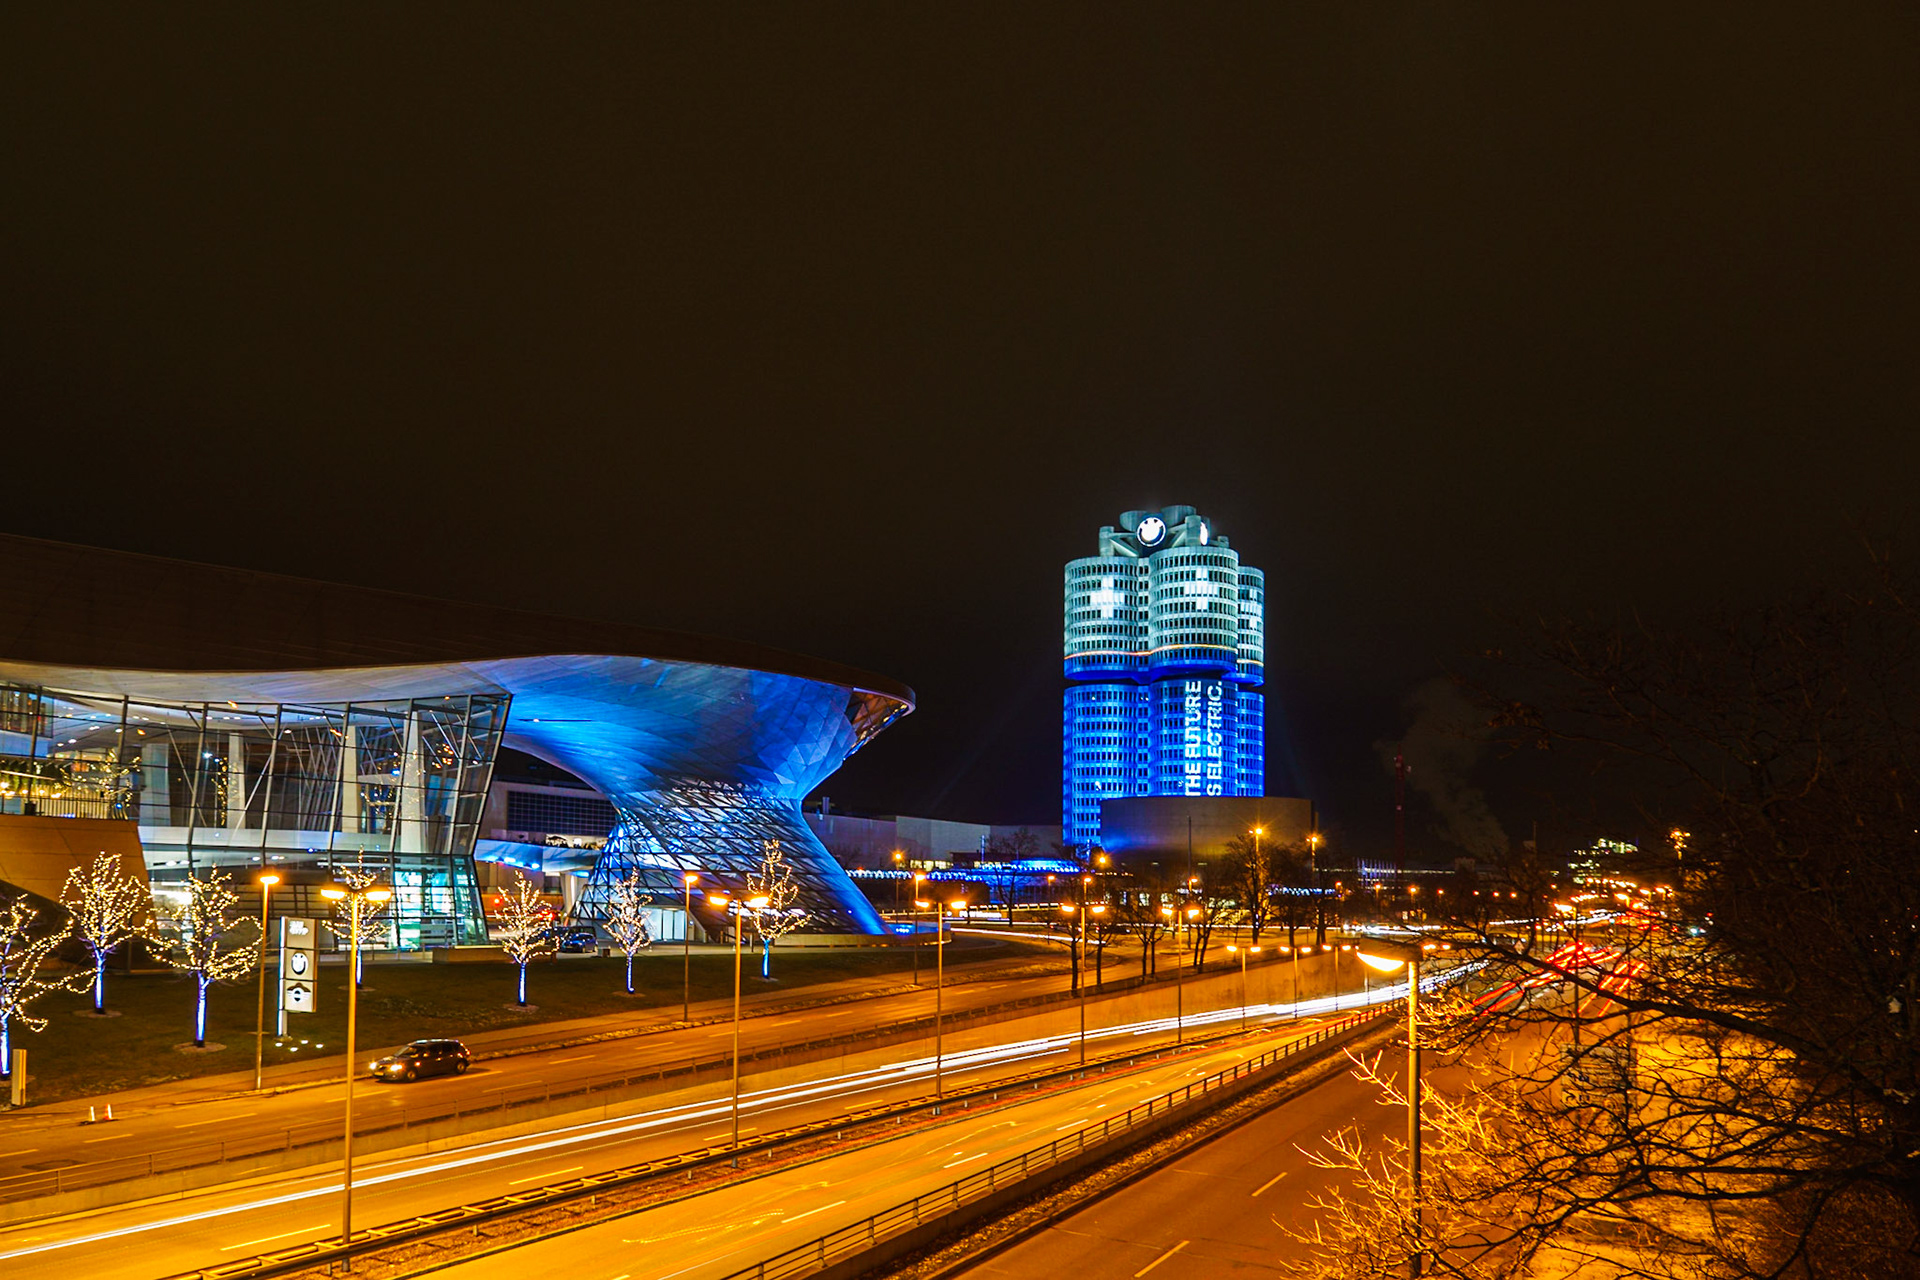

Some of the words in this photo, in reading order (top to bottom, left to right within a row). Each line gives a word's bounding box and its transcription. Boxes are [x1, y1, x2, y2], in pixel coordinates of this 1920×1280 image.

[1185, 681, 1202, 759] FUTURE
[1207, 681, 1222, 779] ELECTRIC.
[1207, 783, 1222, 797] S
